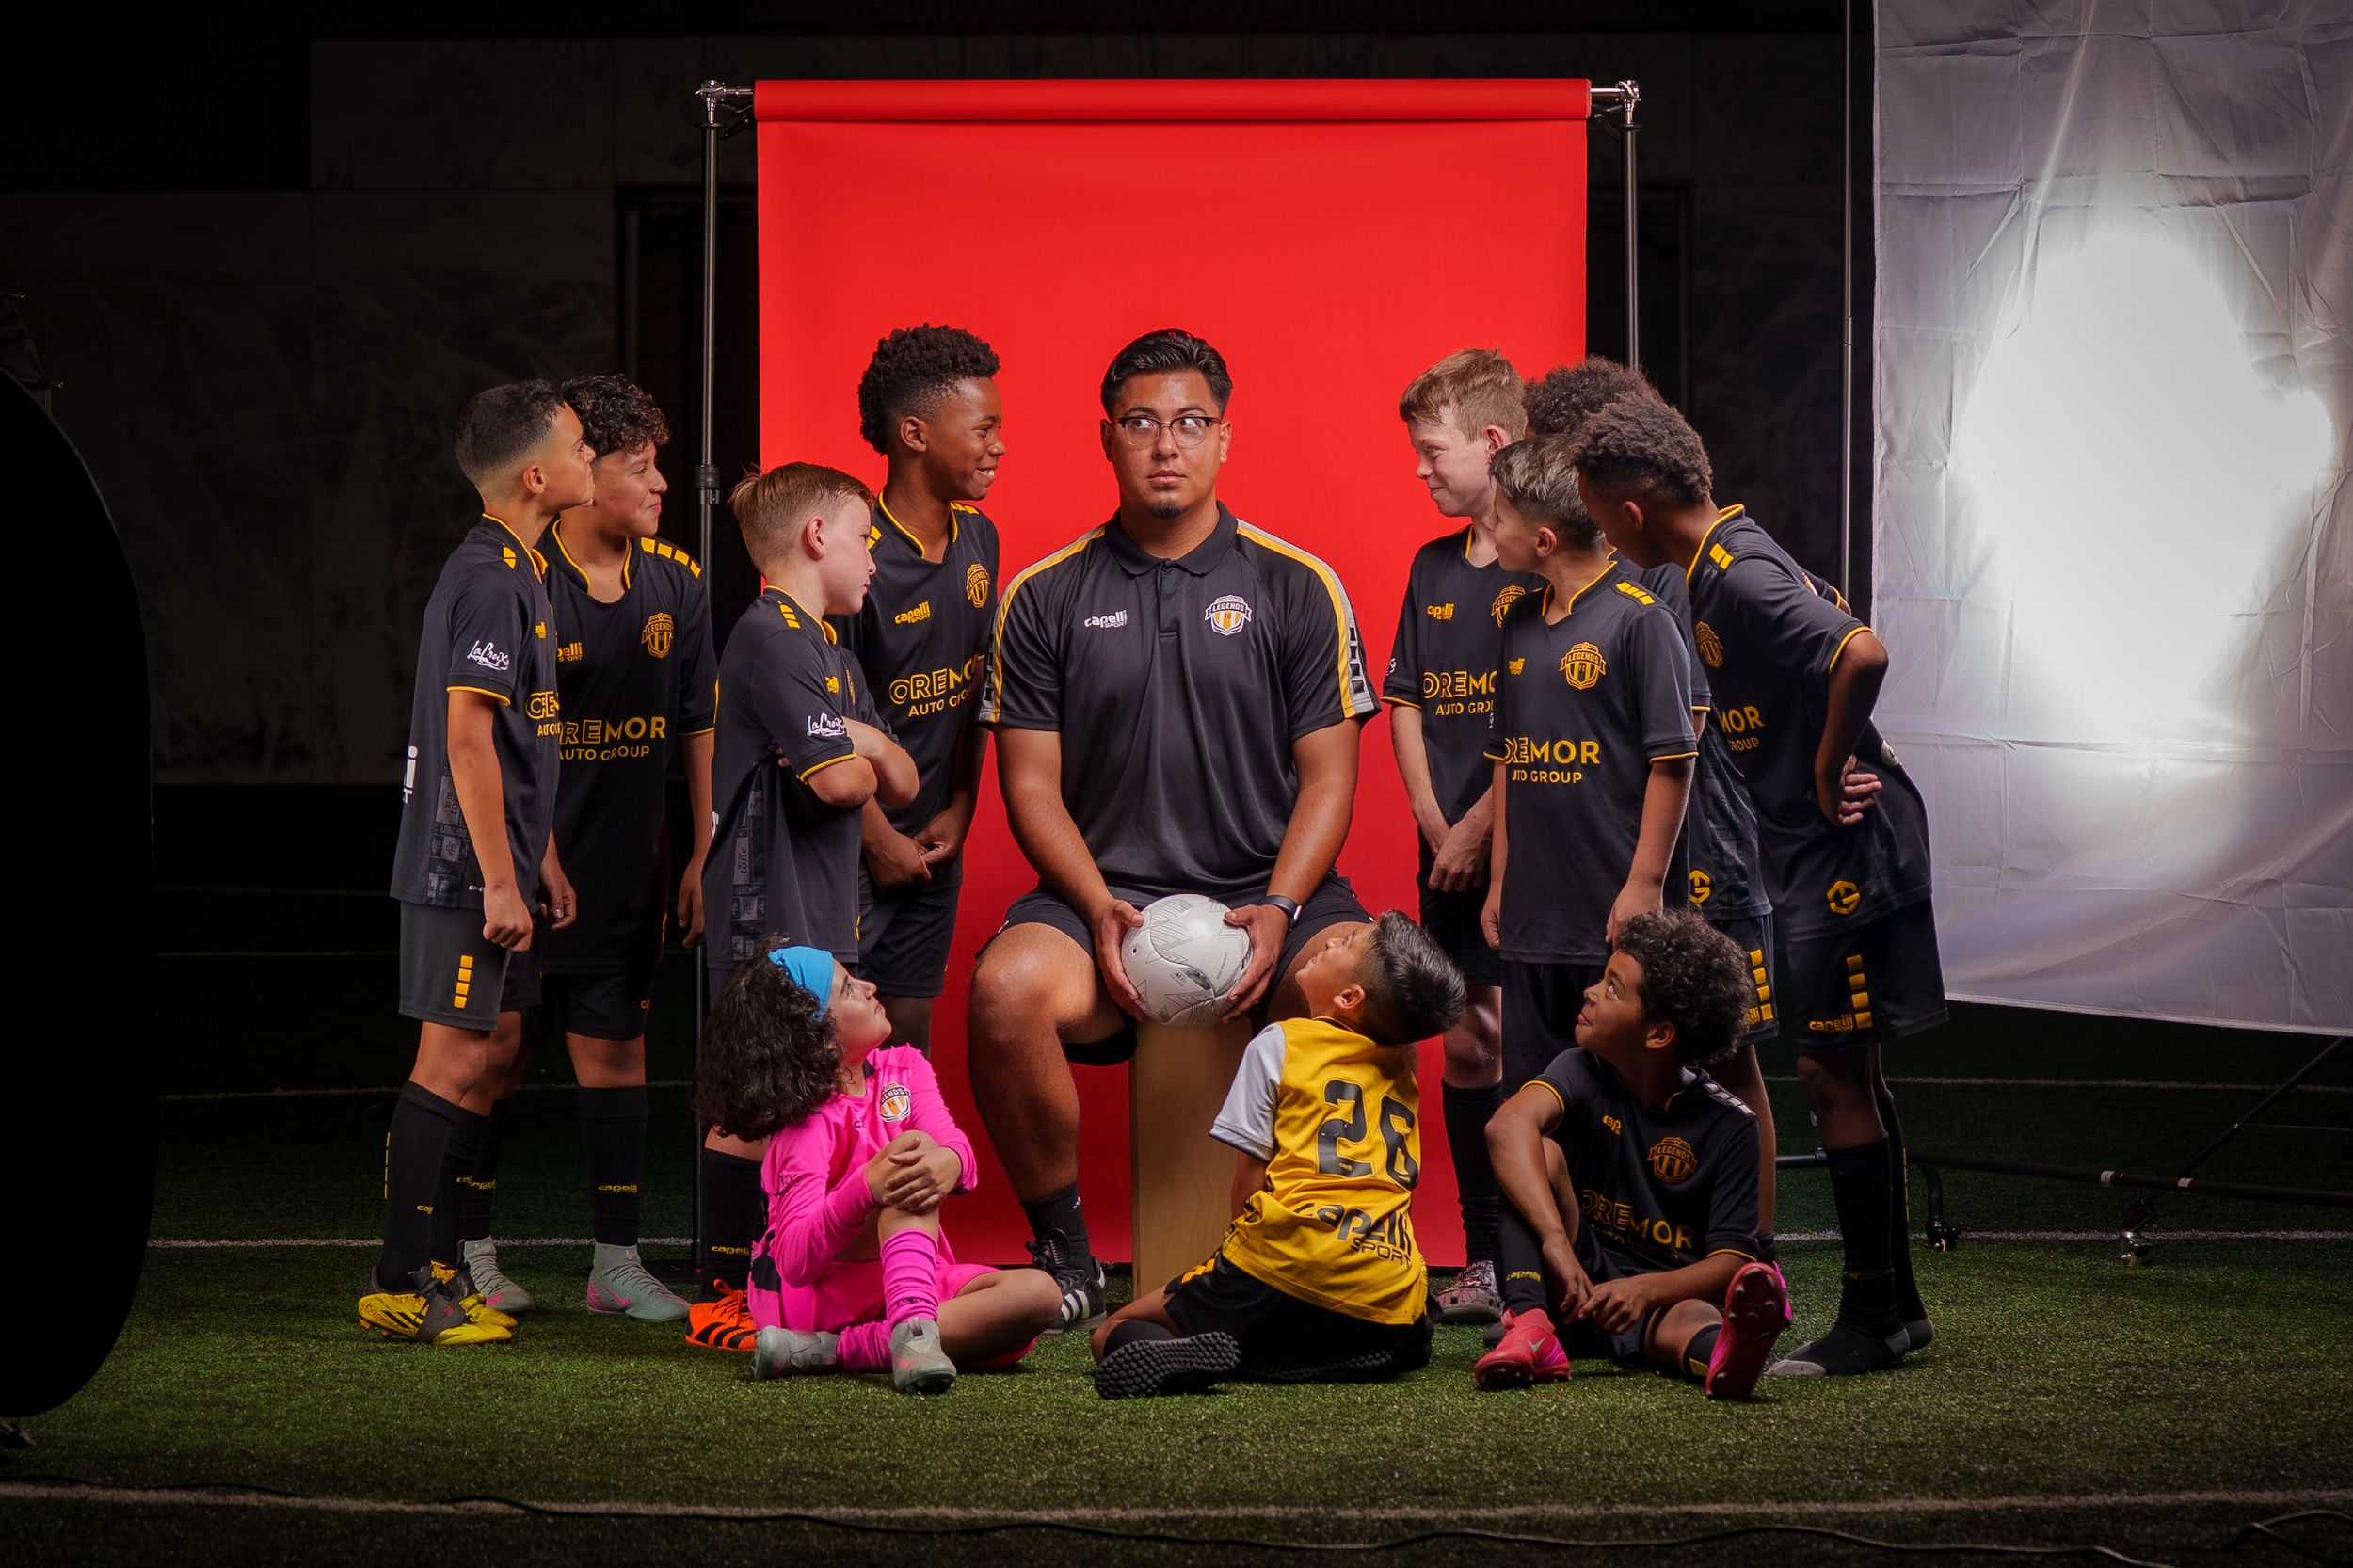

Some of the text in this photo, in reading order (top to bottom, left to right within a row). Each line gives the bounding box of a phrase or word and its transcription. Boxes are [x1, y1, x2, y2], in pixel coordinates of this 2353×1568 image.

[895, 600, 931, 624] capelli
[1211, 602, 1246, 613] LEGENDS
[1084, 610, 1128, 628] capelli
[1567, 651, 1600, 664] LEGENDS
[908, 699, 944, 717] AUTO
[1530, 770, 1582, 784] GROUP
[1318, 1079, 1418, 1191] 26
[1657, 1145, 1691, 1162] LEGENDS
